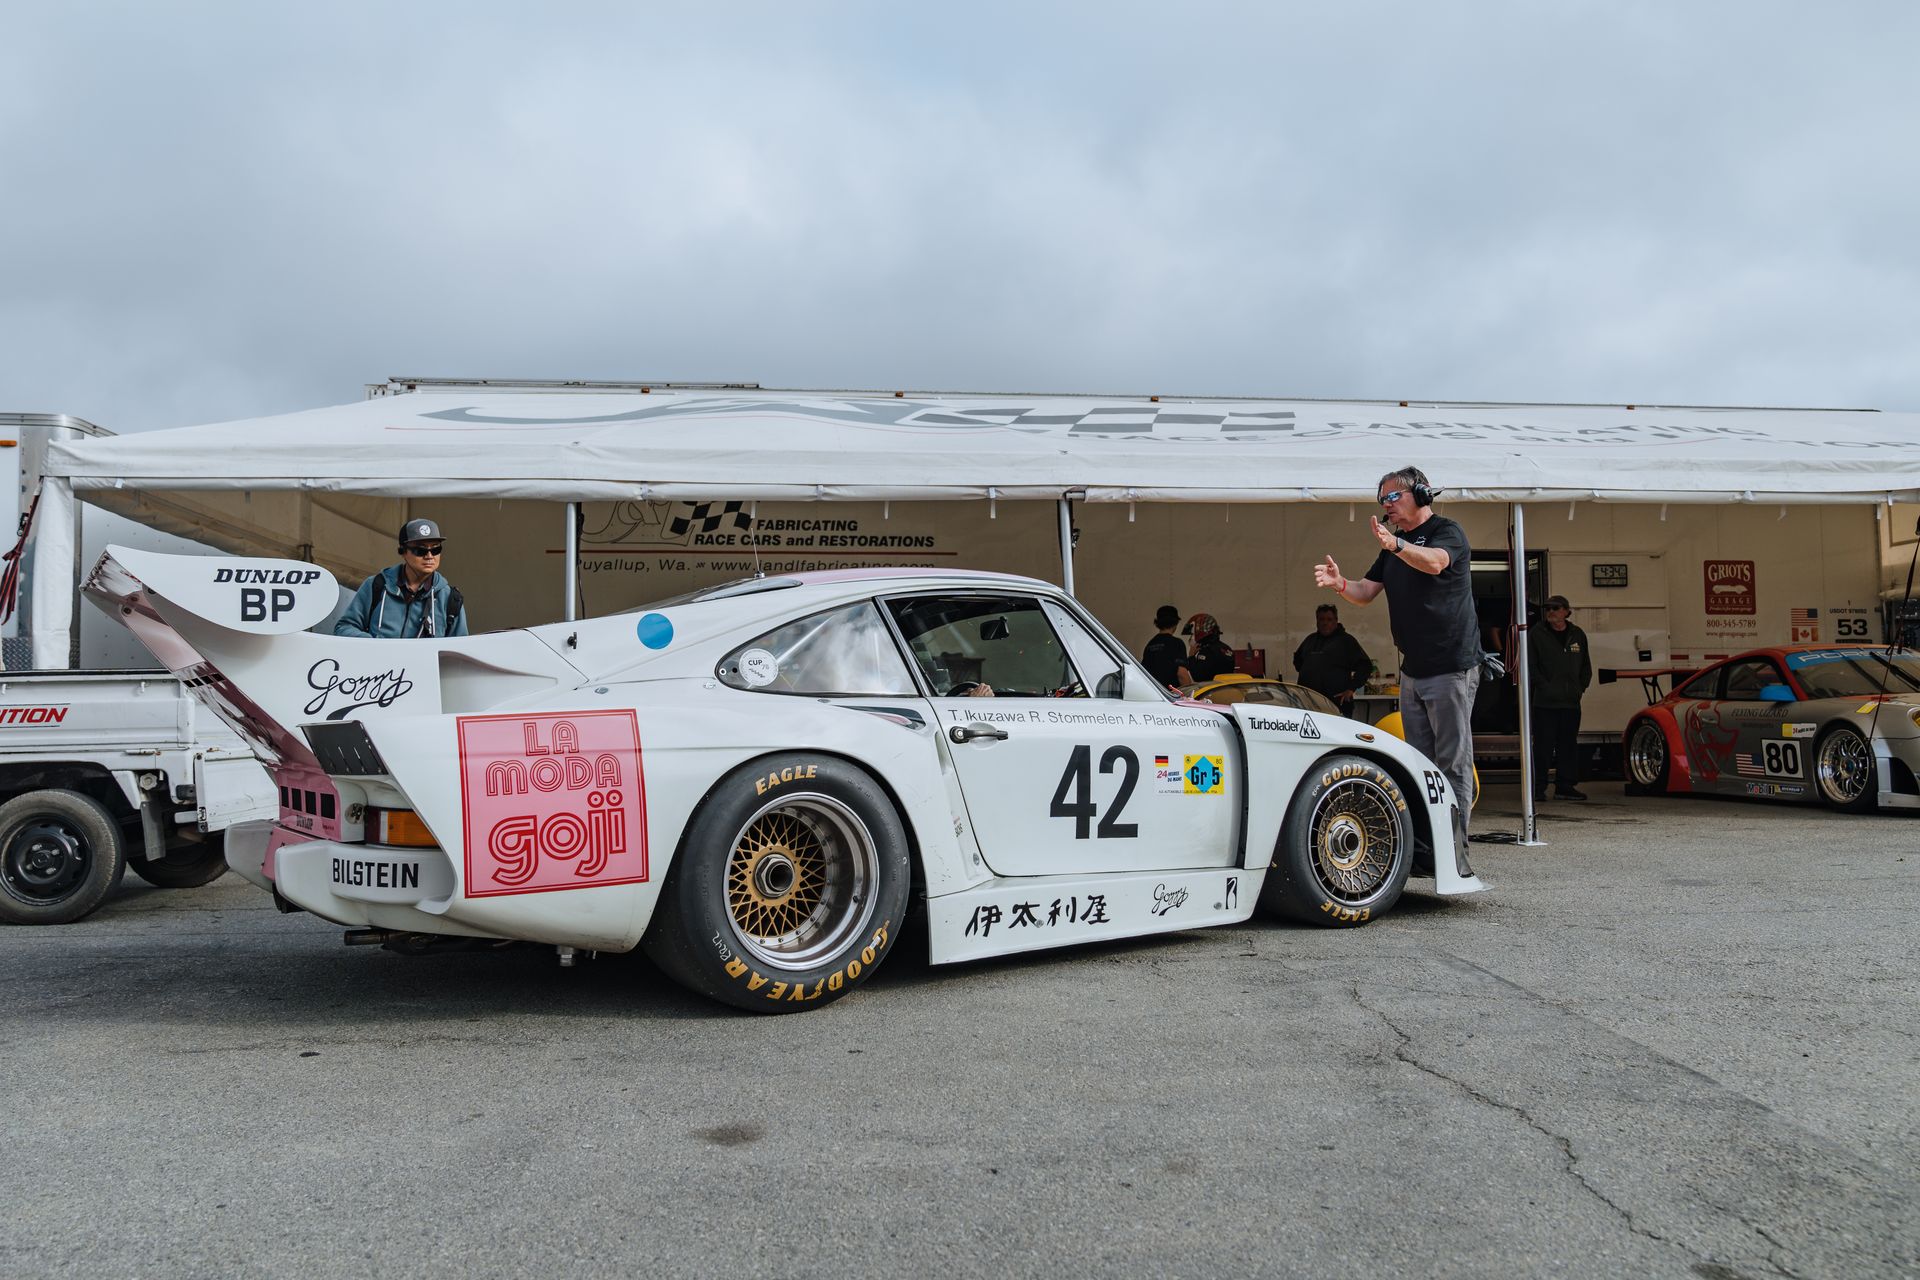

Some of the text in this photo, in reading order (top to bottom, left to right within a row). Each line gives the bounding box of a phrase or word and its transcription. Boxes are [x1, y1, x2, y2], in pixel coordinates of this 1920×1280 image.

[757, 519, 858, 531] FABRICATING
[694, 534, 935, 547] RACE CARS and RESTORATIONS
[659, 559, 691, 571] Wa.
[1708, 563, 1751, 582] GRIOT'S
[213, 568, 321, 585] DUNLOP
[241, 588, 296, 622] BP
[1837, 619, 1868, 636] 53
[948, 709, 1221, 729] T. Ikuzawa R. Stommelen A. Plankenhorn
[1248, 717, 1300, 733] Turbolader
[523, 721, 580, 757] LA
[1765, 742, 1799, 775] 80
[486, 754, 622, 796] MODA
[755, 764, 818, 796] EAGLE
[1156, 770, 1168, 779] 24
[1190, 766, 1220, 785] Gr 5
[1050, 745, 1140, 840] 42
[1423, 770, 1446, 805] BP
[488, 790, 627, 886] goji
[332, 858, 419, 888] BILSTEIN
[1320, 899, 1370, 921] EAGLE
